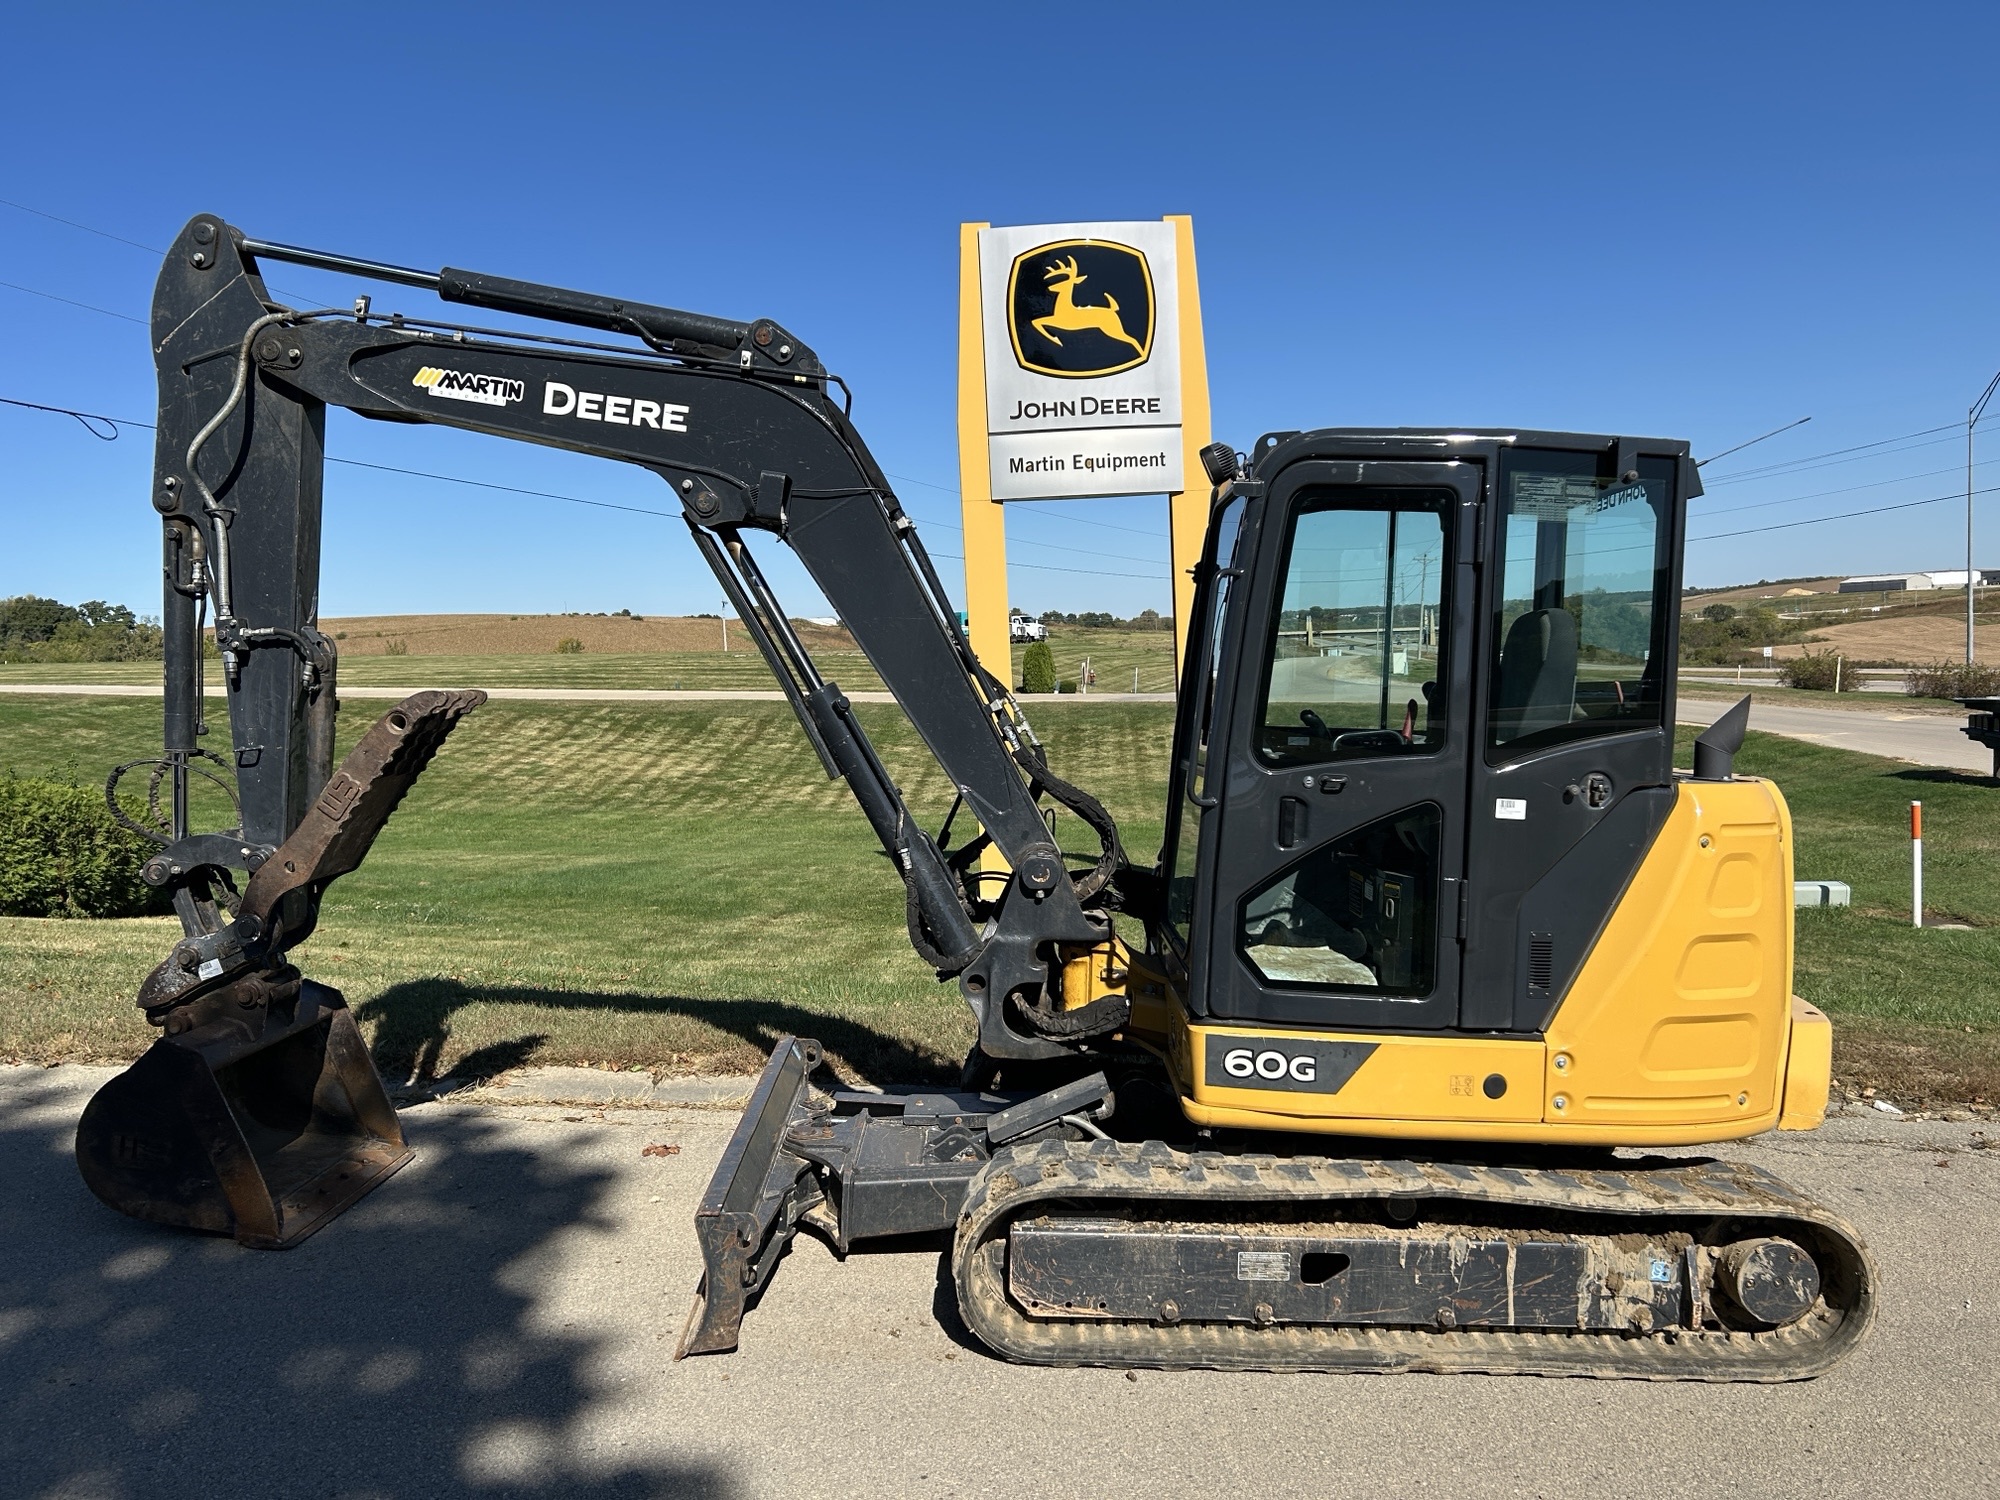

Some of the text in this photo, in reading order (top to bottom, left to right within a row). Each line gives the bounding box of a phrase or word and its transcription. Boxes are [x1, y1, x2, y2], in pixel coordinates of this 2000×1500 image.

[437, 372, 522, 400] MARTIN
[543, 381, 690, 433] DEERE
[1009, 396, 1161, 420] JOHN DEERE
[1009, 451, 1167, 473] Martin Equipment
[1223, 1048, 1317, 1083] 60G
